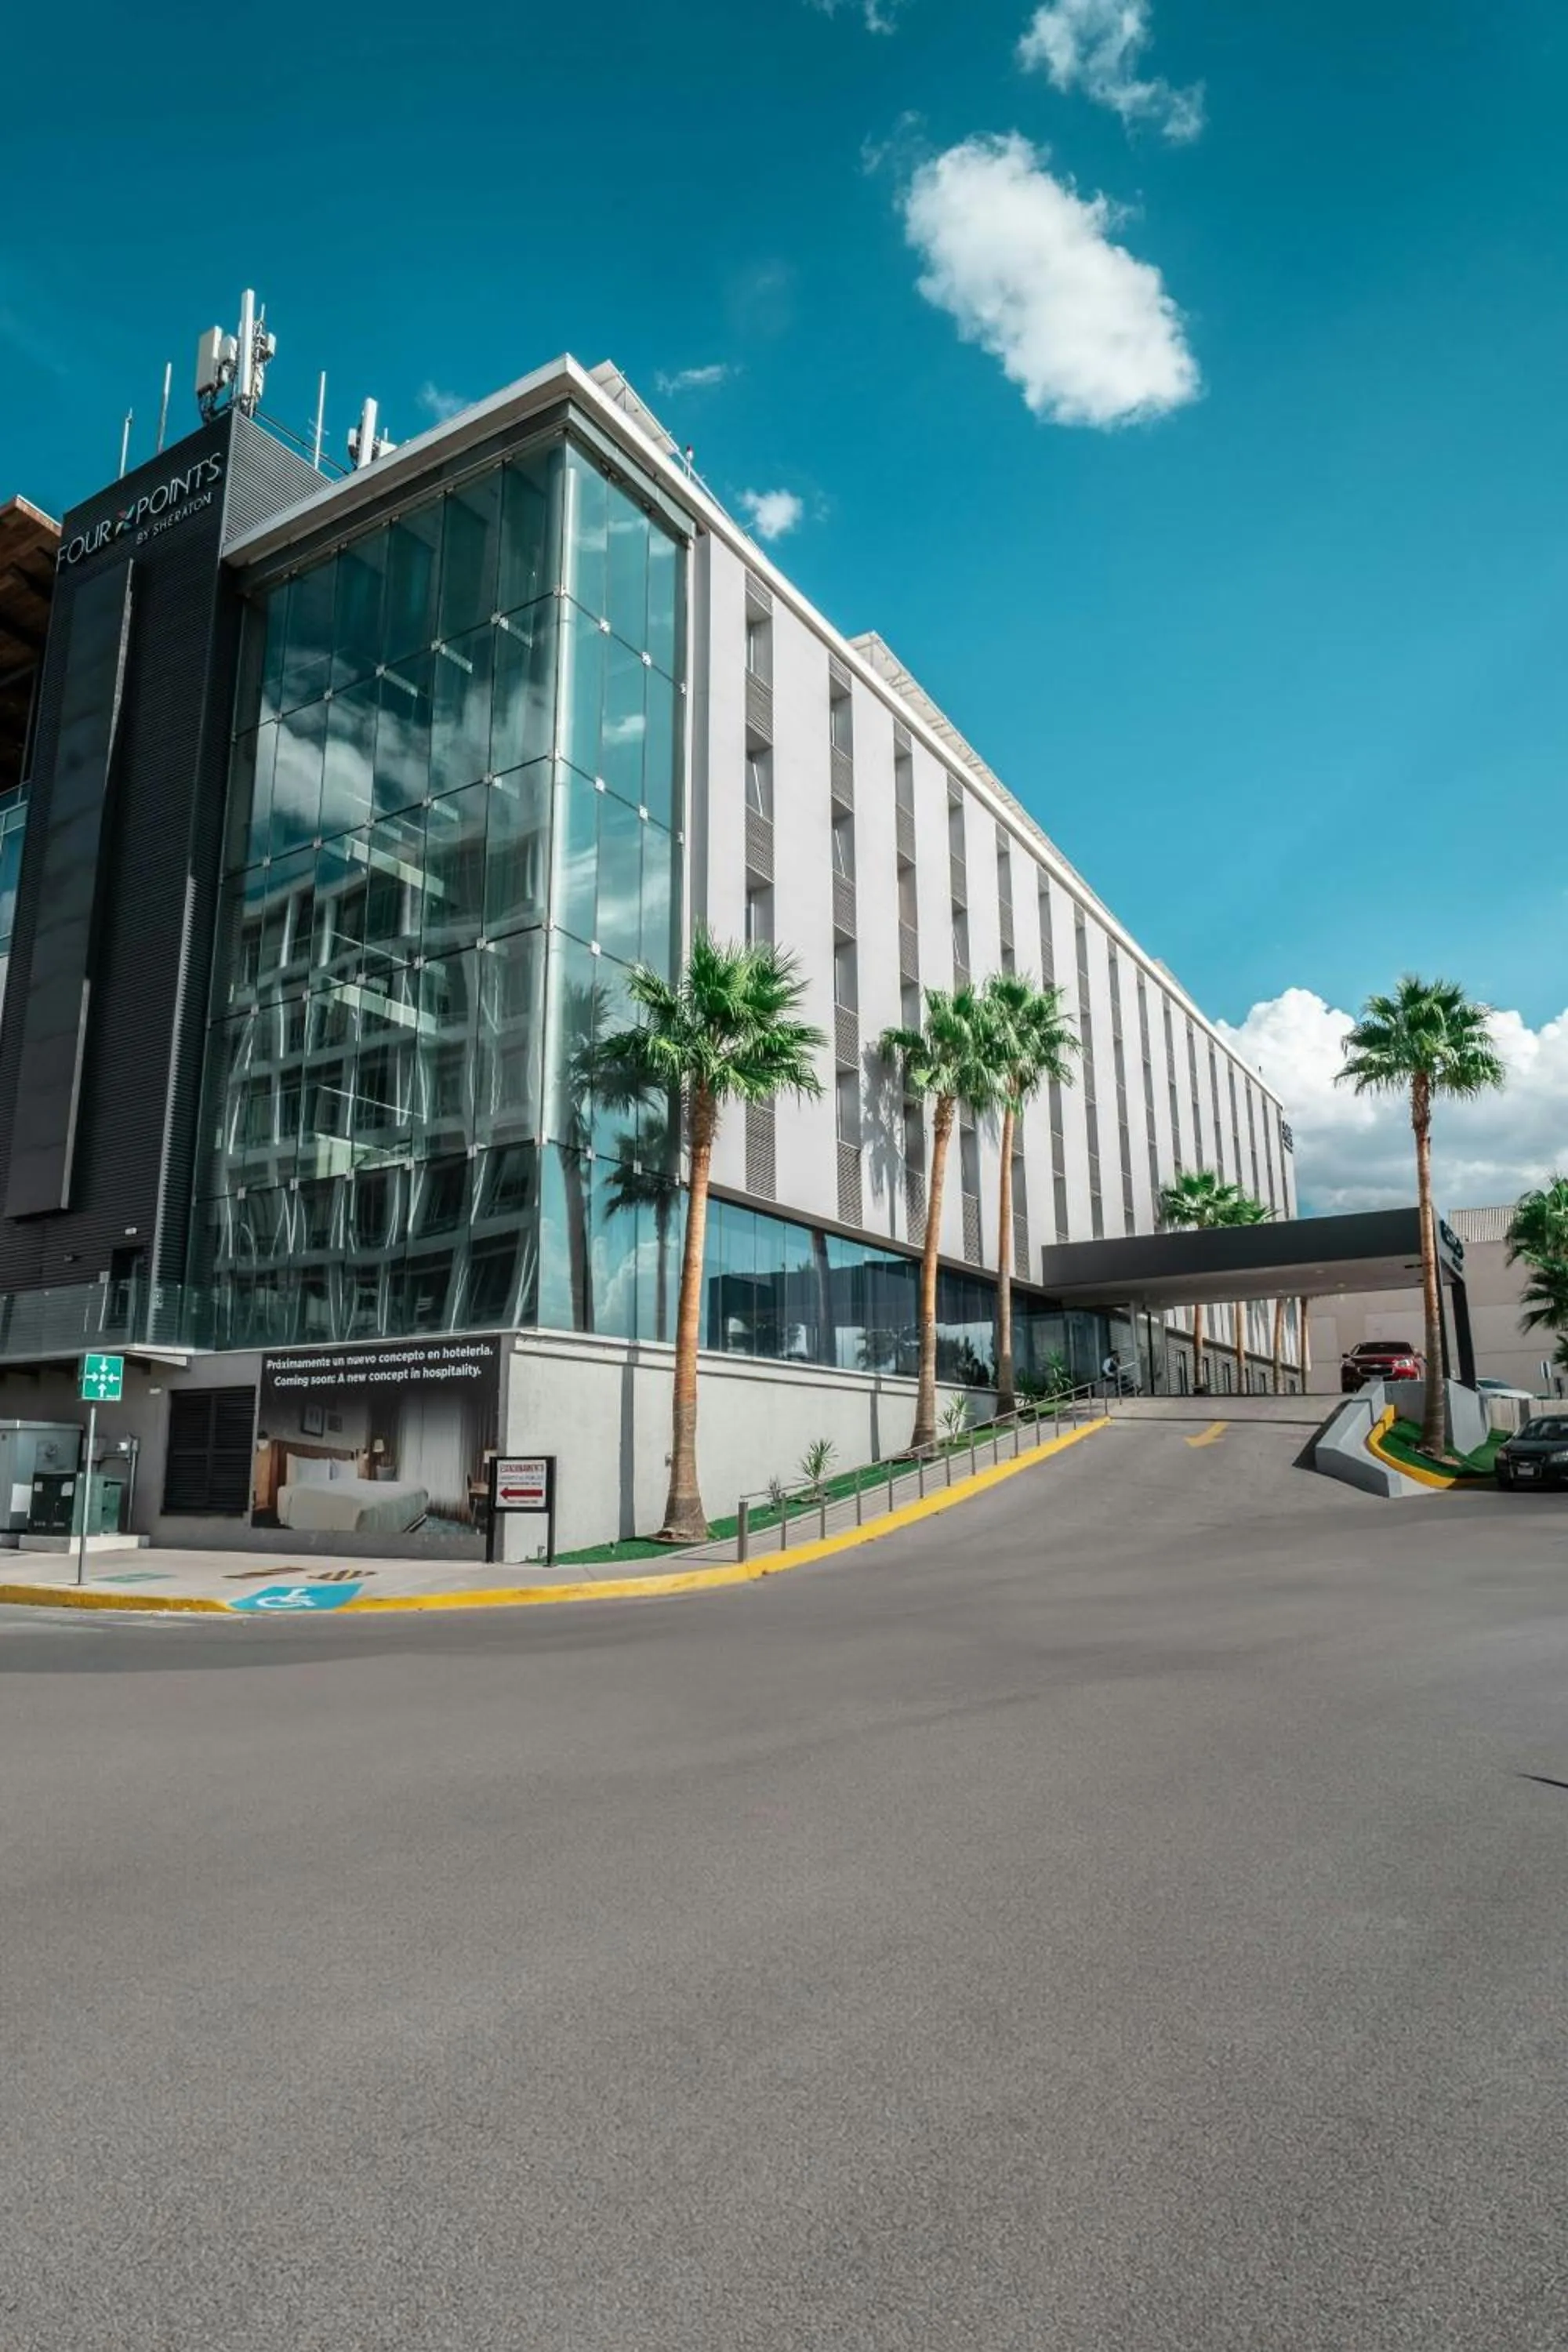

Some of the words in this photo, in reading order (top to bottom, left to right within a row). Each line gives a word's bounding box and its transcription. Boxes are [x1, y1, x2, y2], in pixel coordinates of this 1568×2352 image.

[56, 521, 111, 572] FOUR
[136, 452, 223, 524] POINTS
[136, 529, 150, 545] BY
[153, 492, 212, 536] SHERATON
[274, 1374, 309, 1386] Coming
[310, 1375, 336, 1385] soon:
[337, 1373, 345, 1384] A
[347, 1373, 368, 1383] new
[368, 1368, 408, 1382] concept
[410, 1367, 421, 1379] in
[423, 1363, 481, 1378] hospitality.
[332, 1356, 345, 1367] un
[347, 1354, 377, 1366] nuevo
[379, 1349, 425, 1363] concepto
[427, 1350, 440, 1359] en
